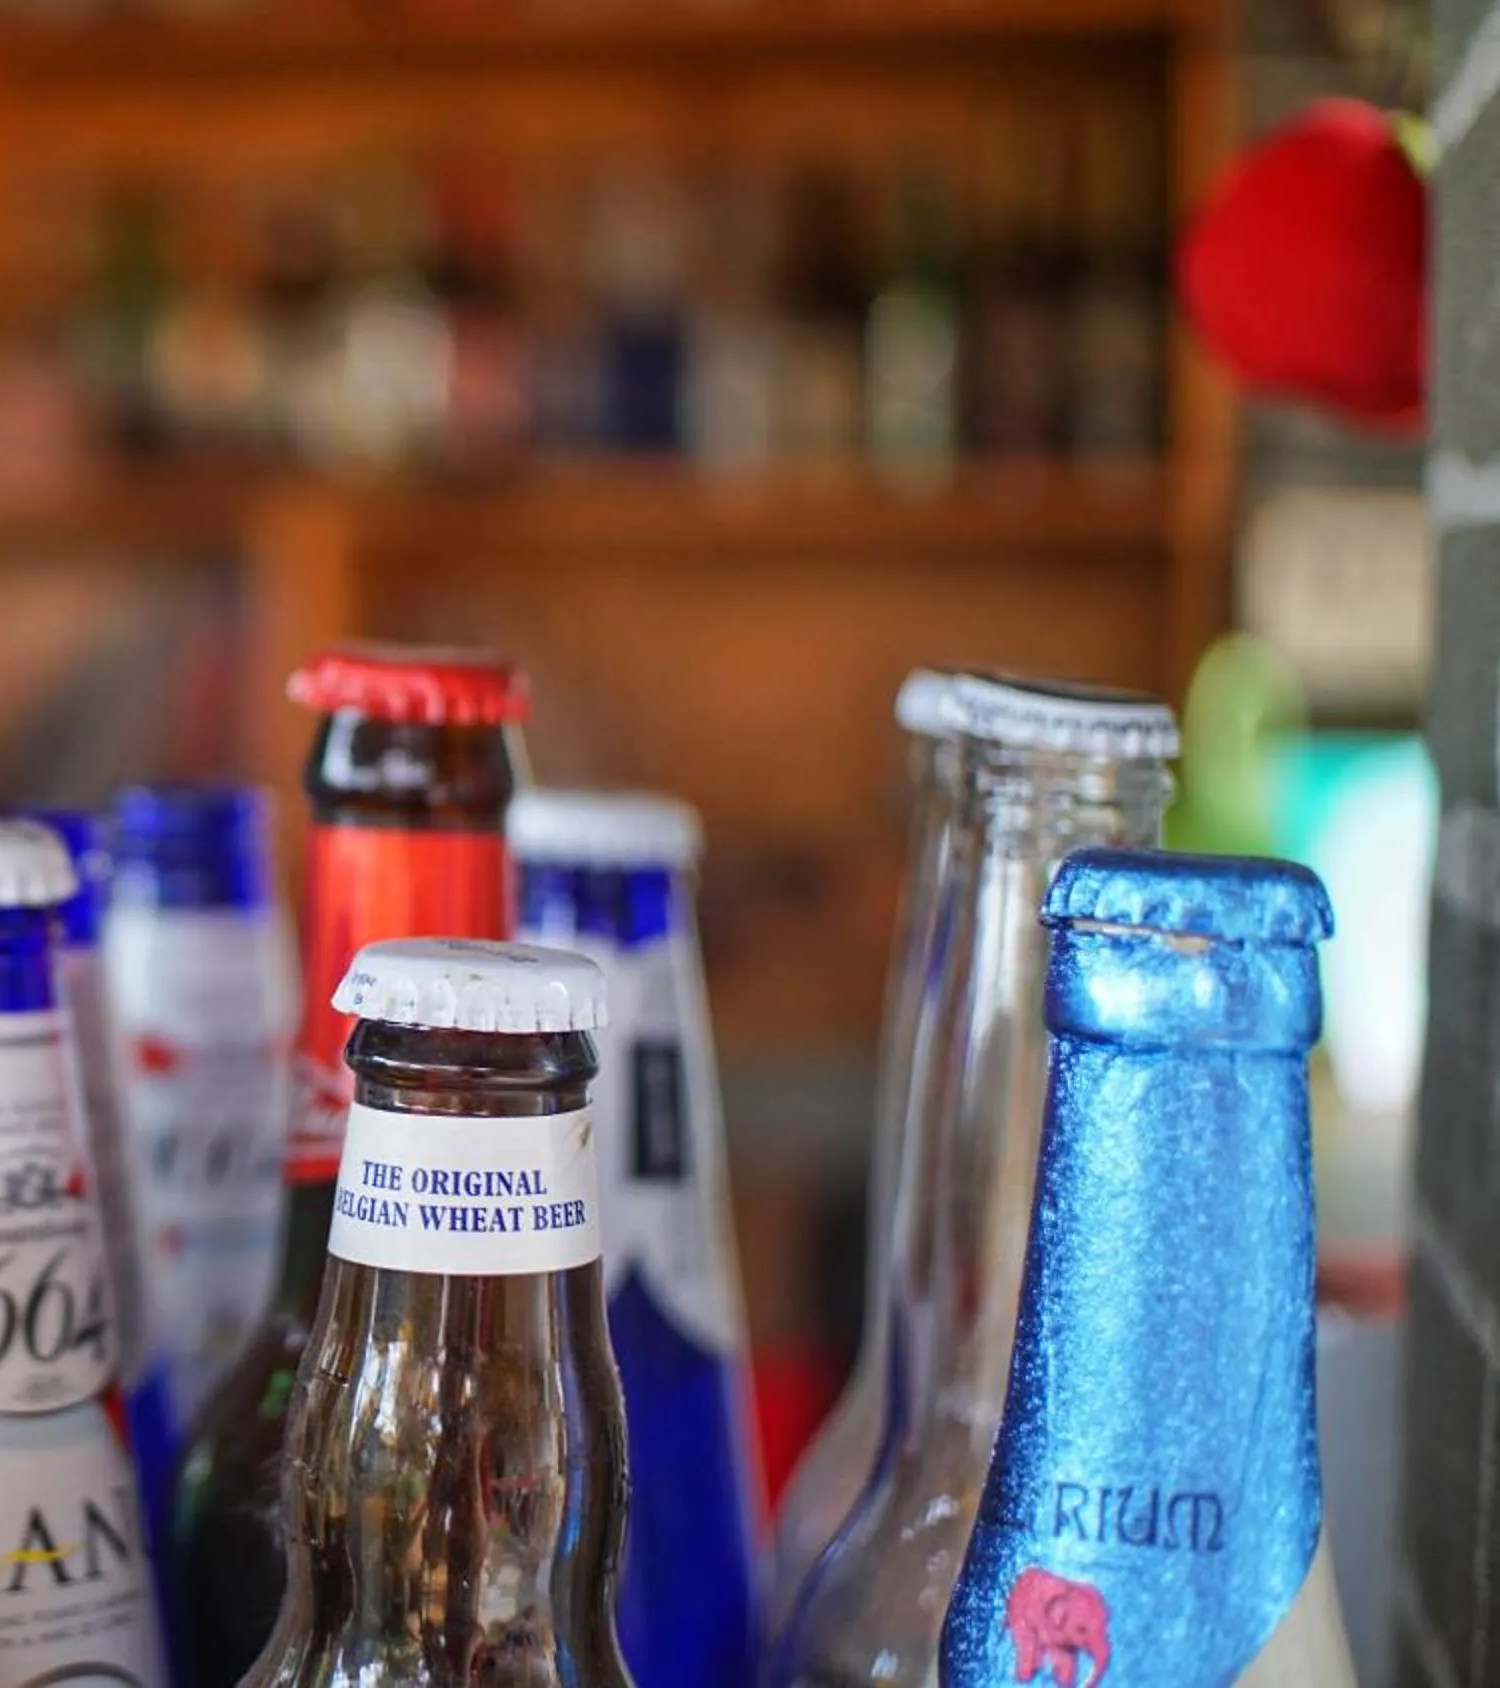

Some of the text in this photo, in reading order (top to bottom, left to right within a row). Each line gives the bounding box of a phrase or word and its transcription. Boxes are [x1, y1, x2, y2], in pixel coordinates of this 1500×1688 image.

[362, 1160, 547, 1197] THE ORIGINAL
[418, 1202, 524, 1233] WHEAT
[532, 1199, 586, 1231] BEER
